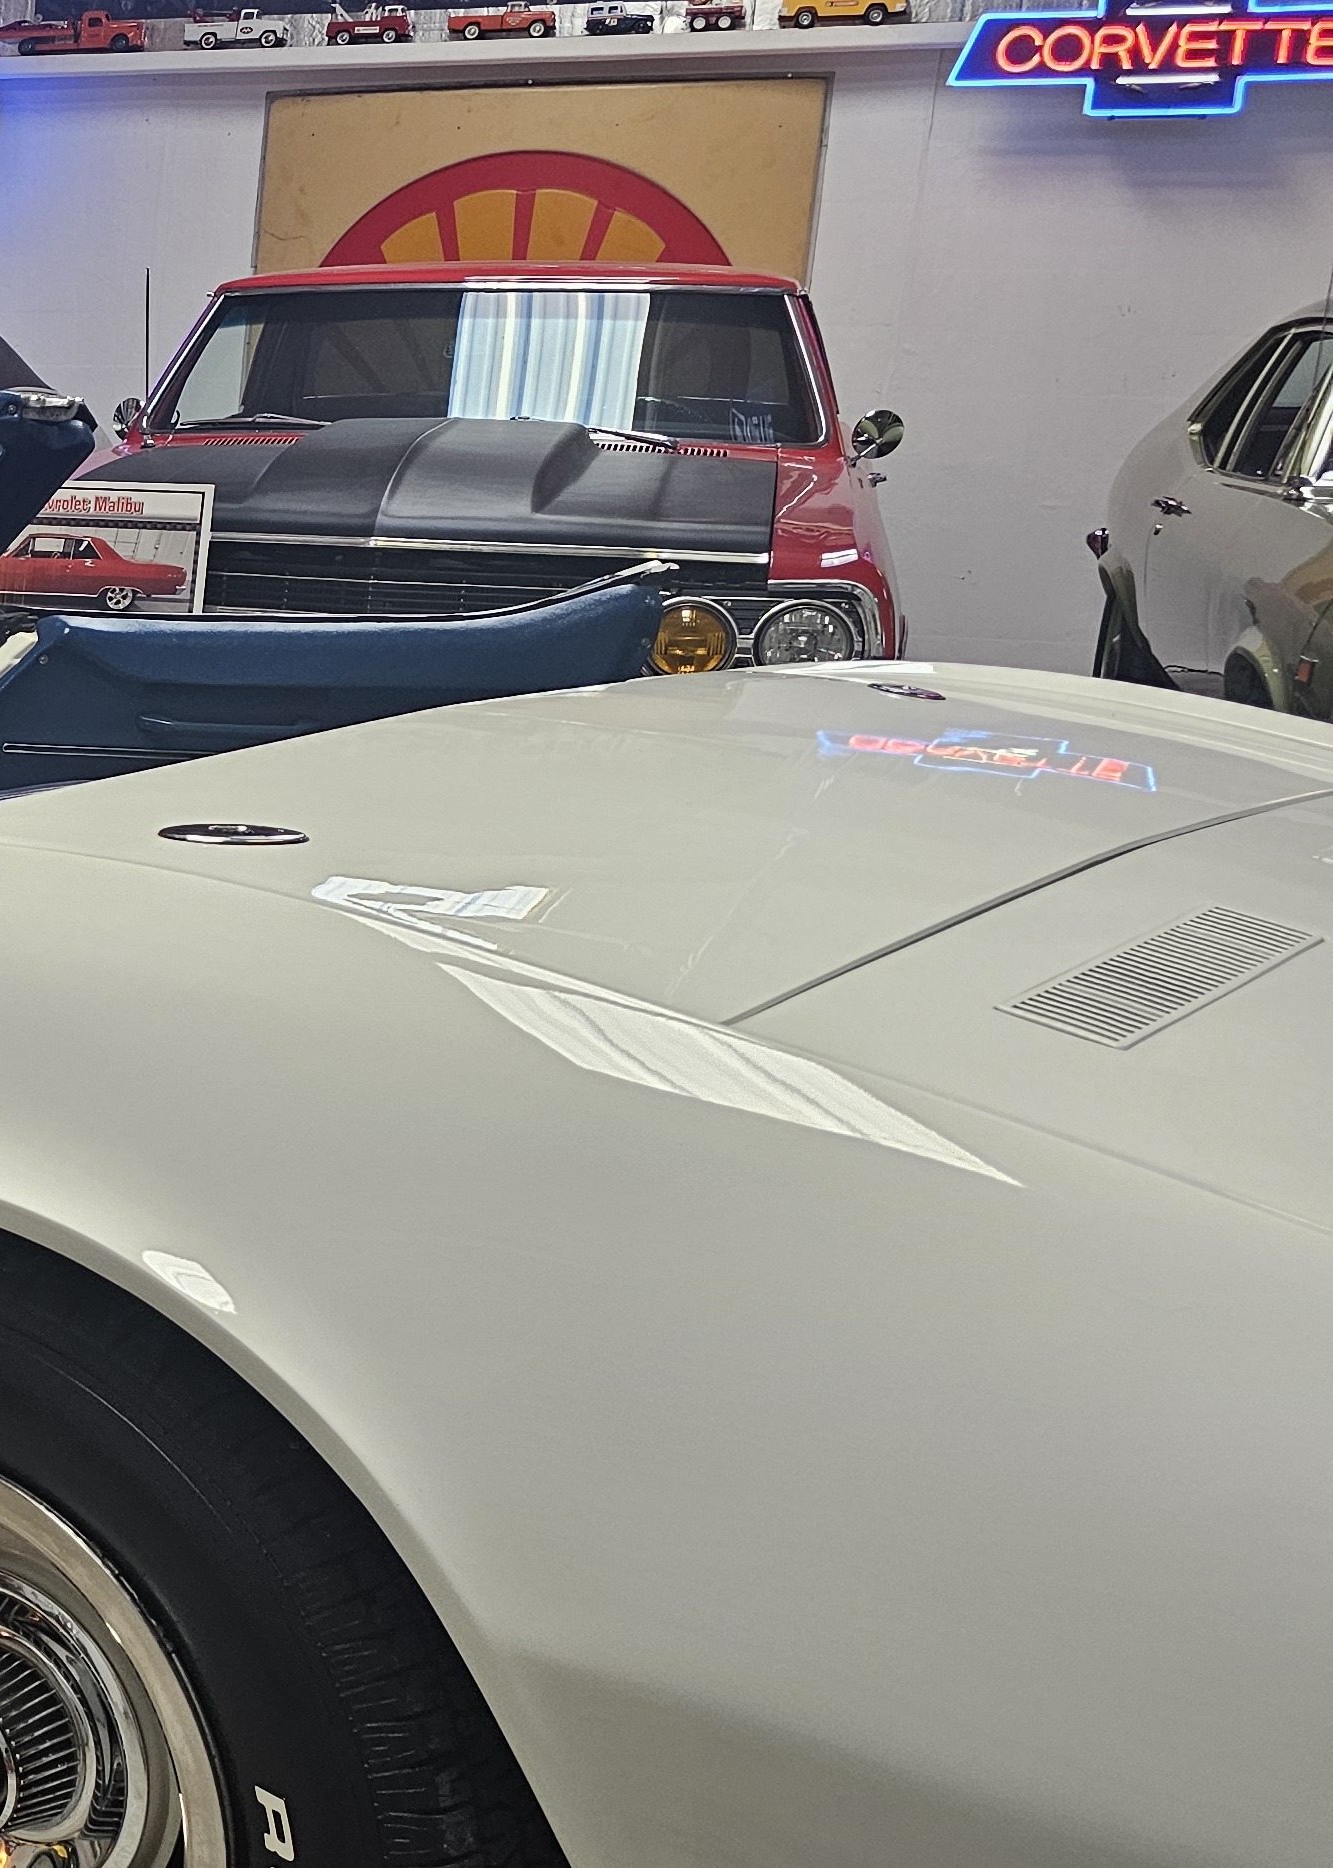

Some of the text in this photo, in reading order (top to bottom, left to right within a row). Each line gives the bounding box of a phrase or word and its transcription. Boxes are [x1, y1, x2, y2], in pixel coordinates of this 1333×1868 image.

[995, 18, 1333, 73] CORVETTE
[45, 495, 144, 514] vrolet Malibu
